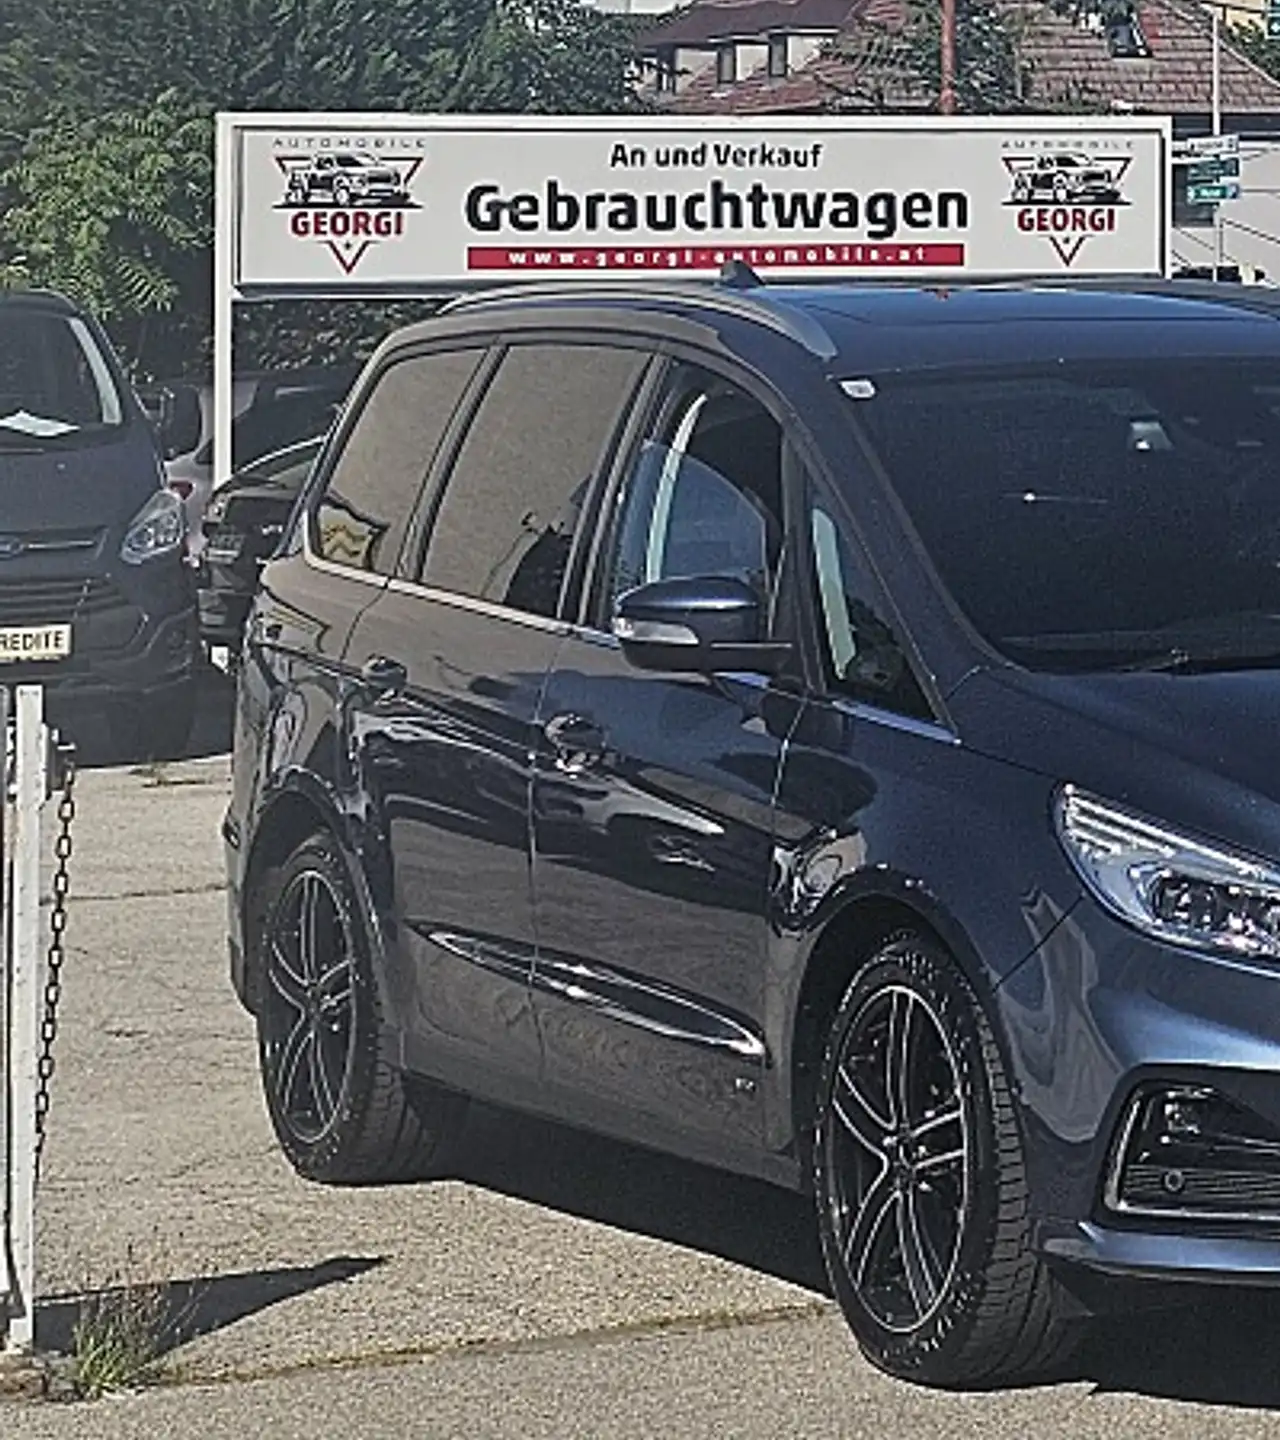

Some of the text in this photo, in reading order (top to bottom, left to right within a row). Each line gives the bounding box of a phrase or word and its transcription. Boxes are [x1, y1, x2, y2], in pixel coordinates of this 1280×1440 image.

[272, 137, 426, 149] AUTOMOBILE
[610, 143, 823, 168] An und Verkauf
[466, 180, 969, 239] Gebrauchtwagen
[1017, 208, 1115, 232] GEORGI
[290, 211, 404, 236] GEORGI
[508, 247, 927, 266] www.georgi-automobile.at
